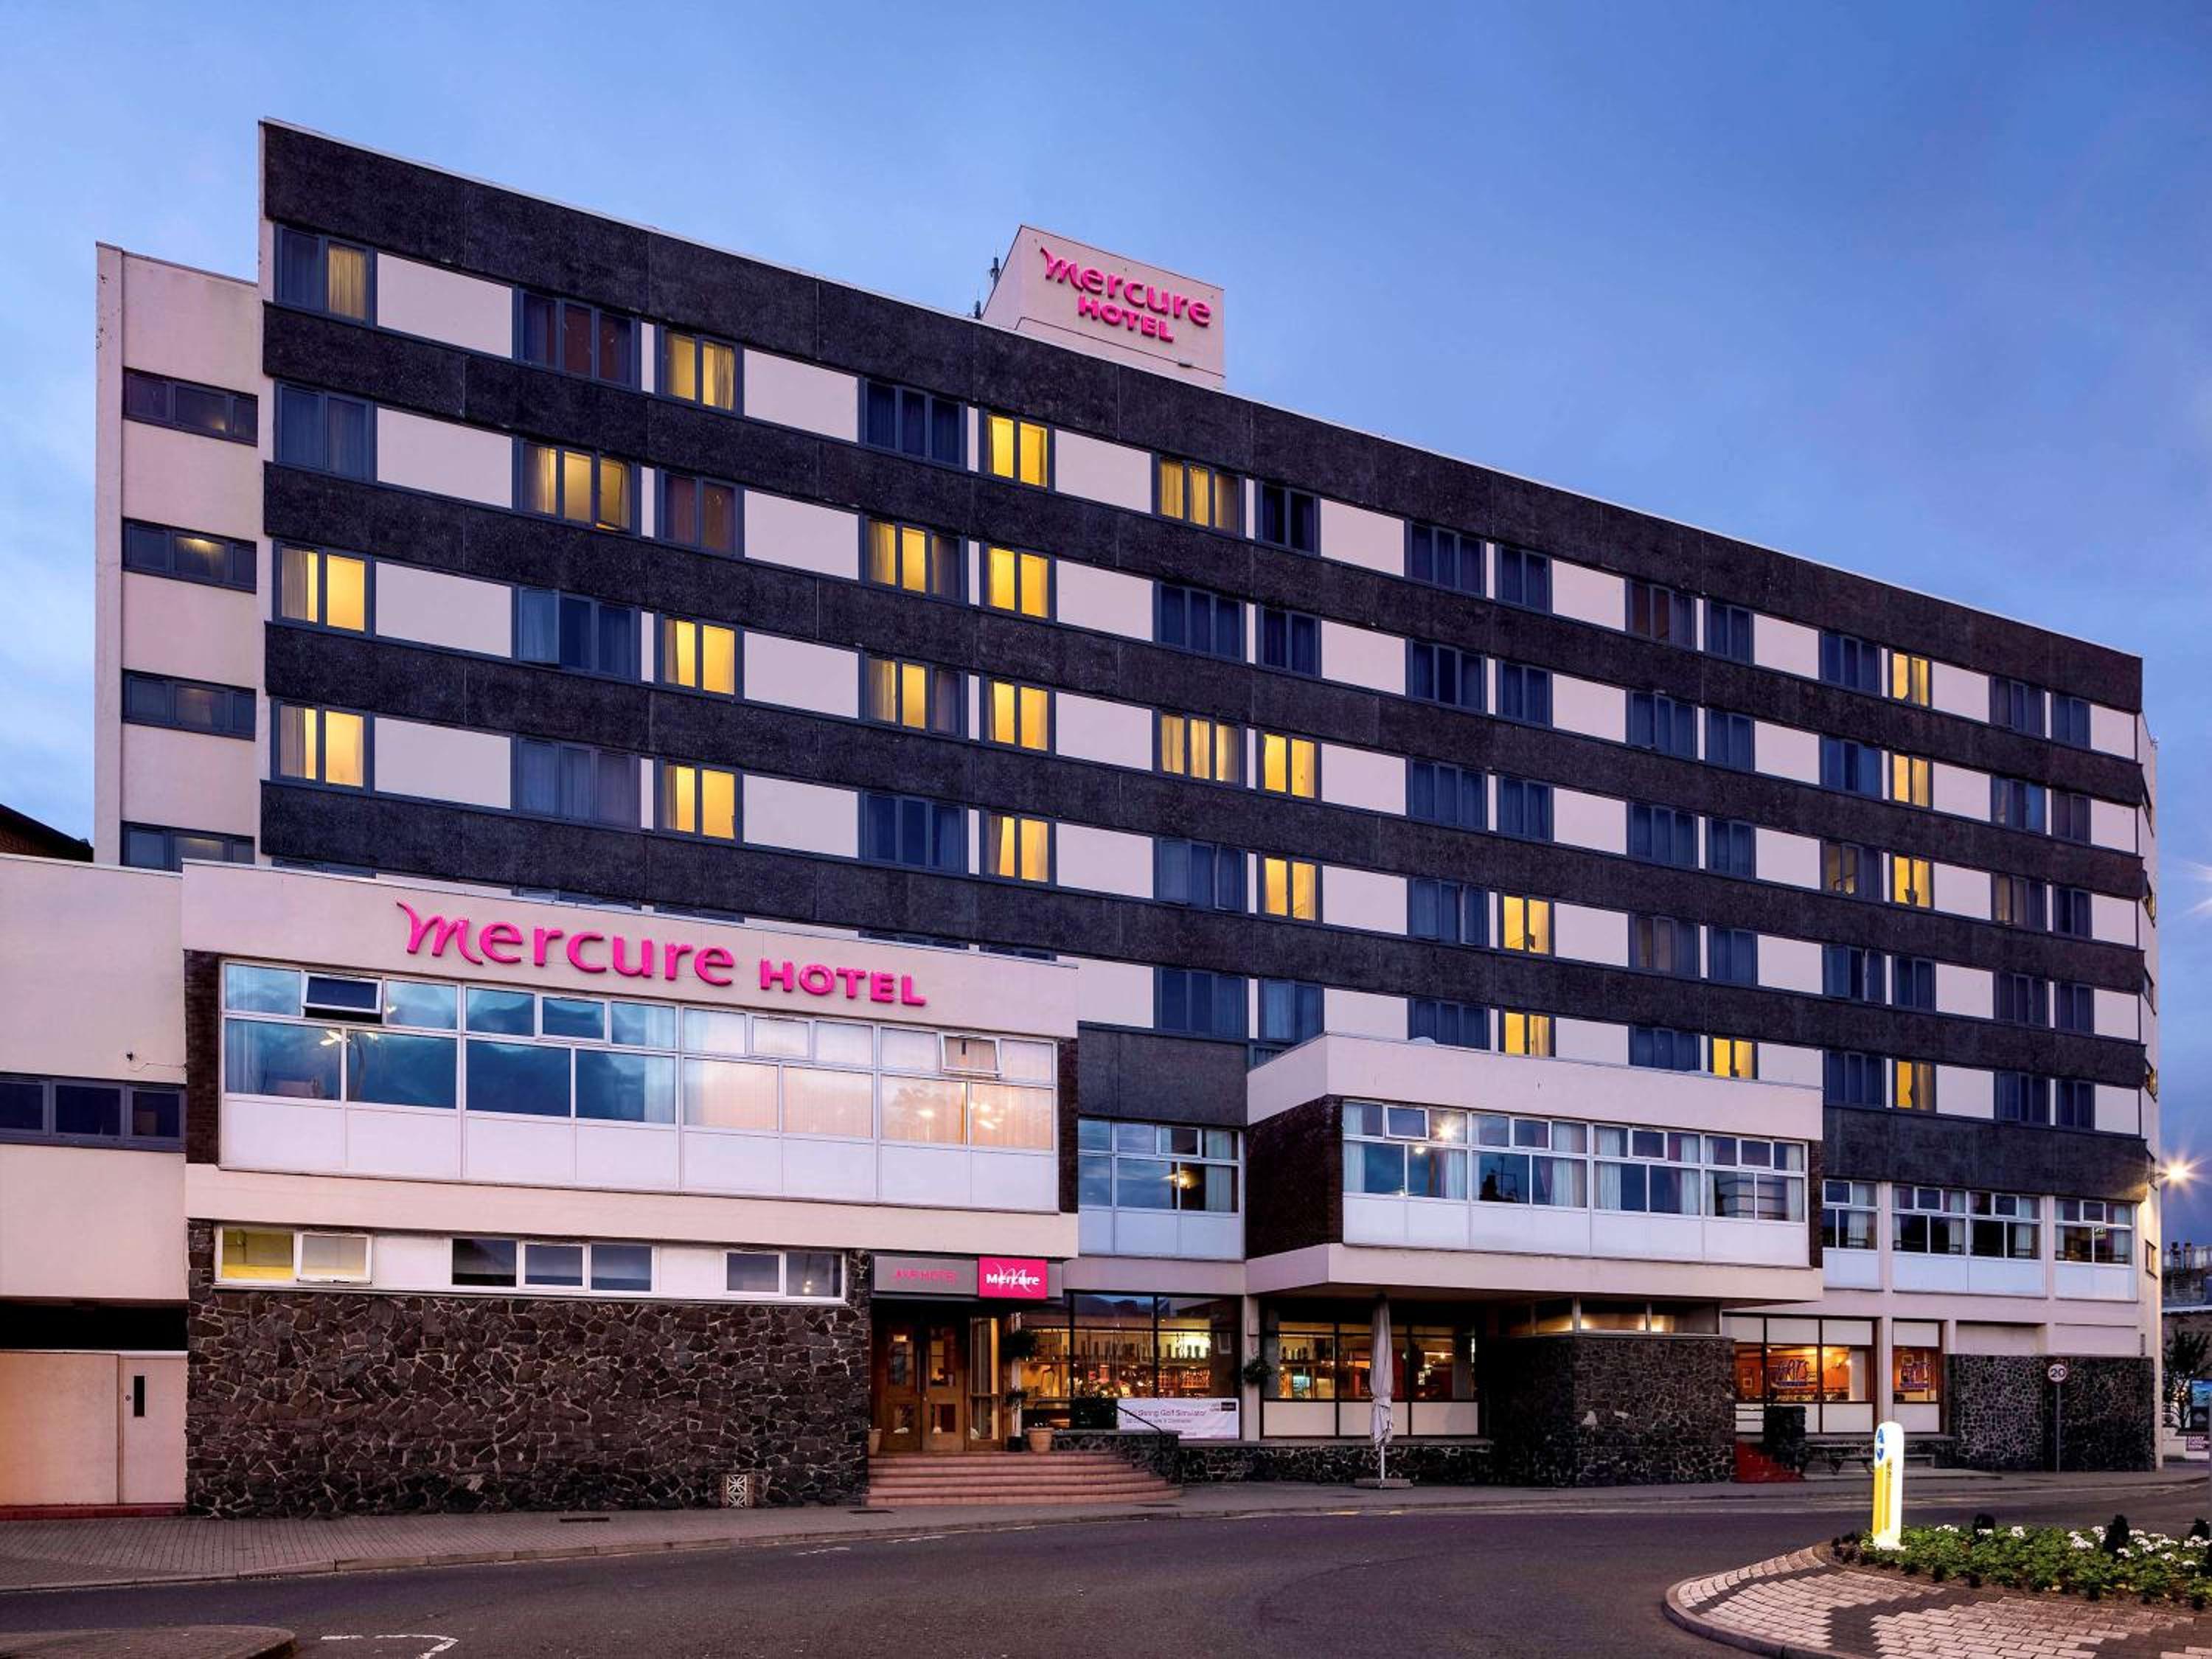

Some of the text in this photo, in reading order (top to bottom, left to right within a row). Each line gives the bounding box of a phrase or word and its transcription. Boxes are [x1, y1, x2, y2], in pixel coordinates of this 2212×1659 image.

[1077, 294, 1175, 343] HOTEL
[759, 959, 927, 1007] HOTEL
[986, 1273, 1040, 1287] Mercure
[2051, 1368, 2065, 1378] 20
